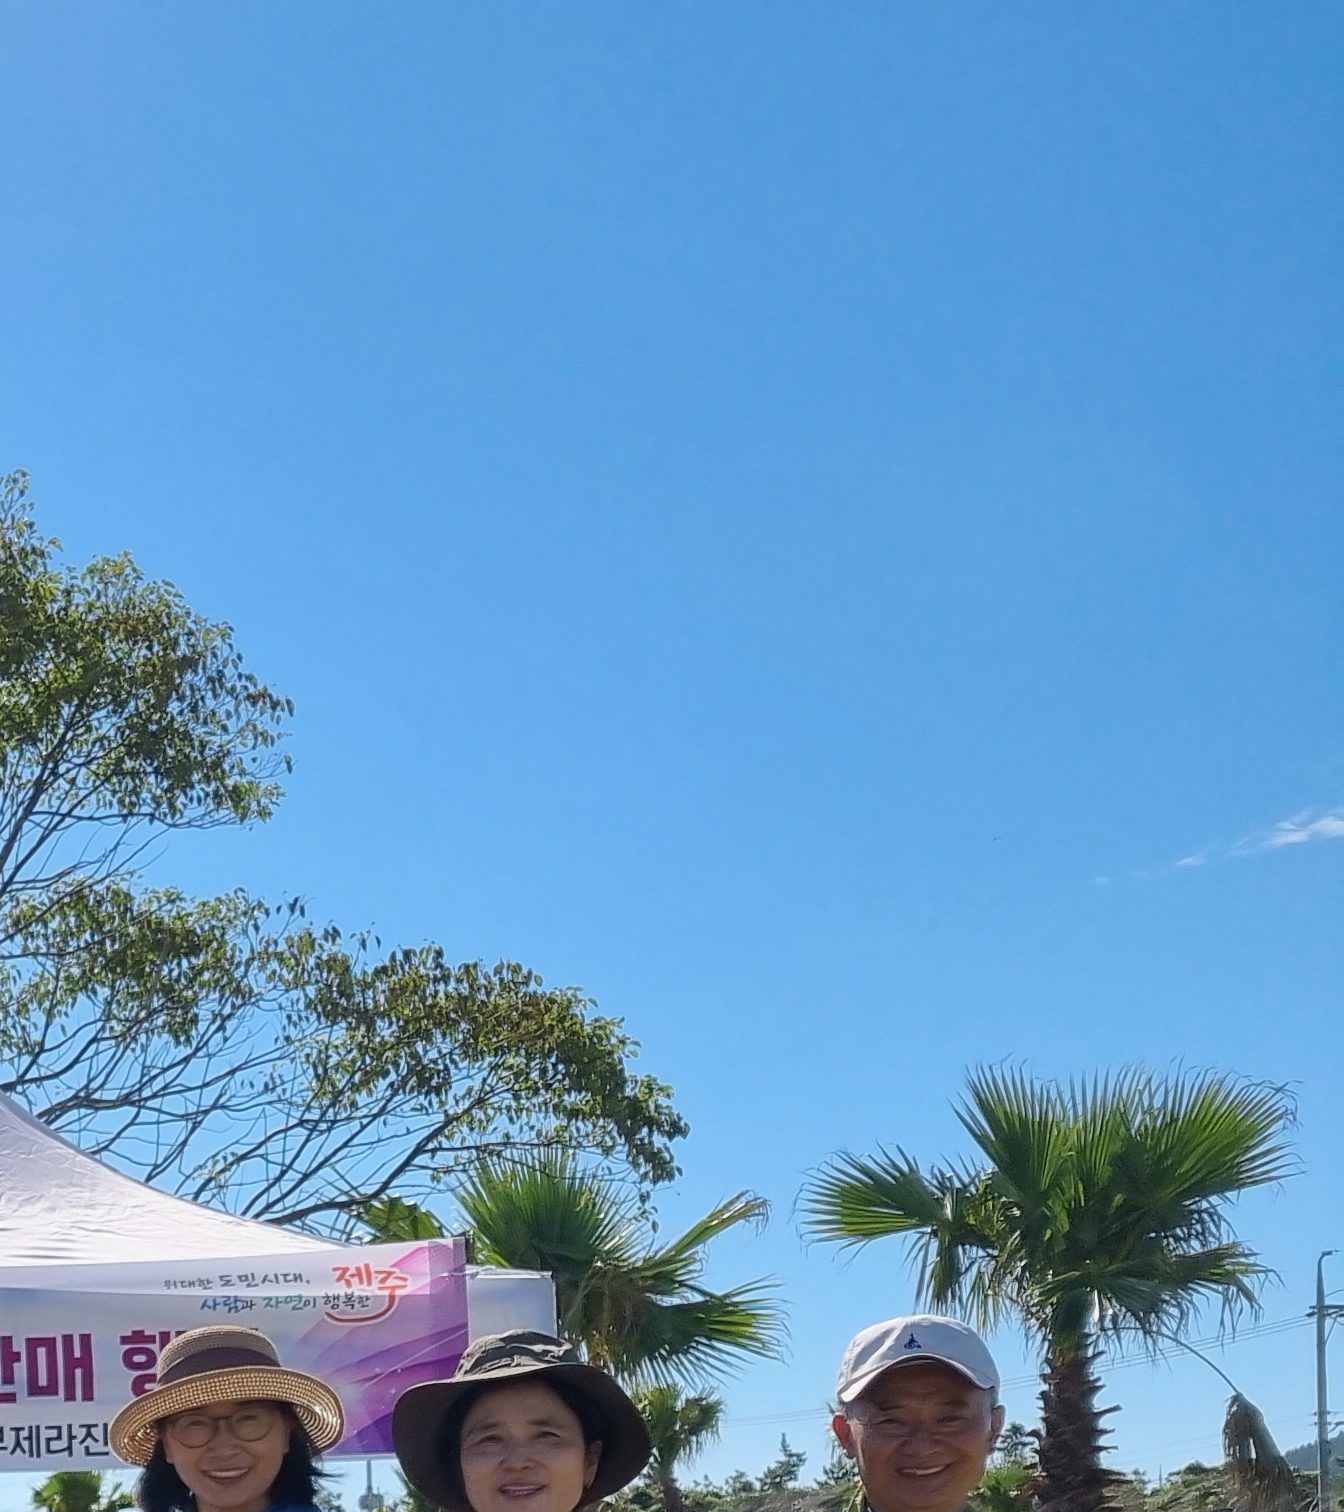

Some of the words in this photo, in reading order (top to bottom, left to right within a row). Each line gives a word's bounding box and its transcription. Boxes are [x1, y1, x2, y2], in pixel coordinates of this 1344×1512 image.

[164, 1276, 212, 1290] 위대한
[324, 1262, 408, 1323] 제주
[201, 1294, 256, 1313] 사람과
[263, 1294, 316, 1311] 자연이
[322, 1292, 370, 1310] 행복한
